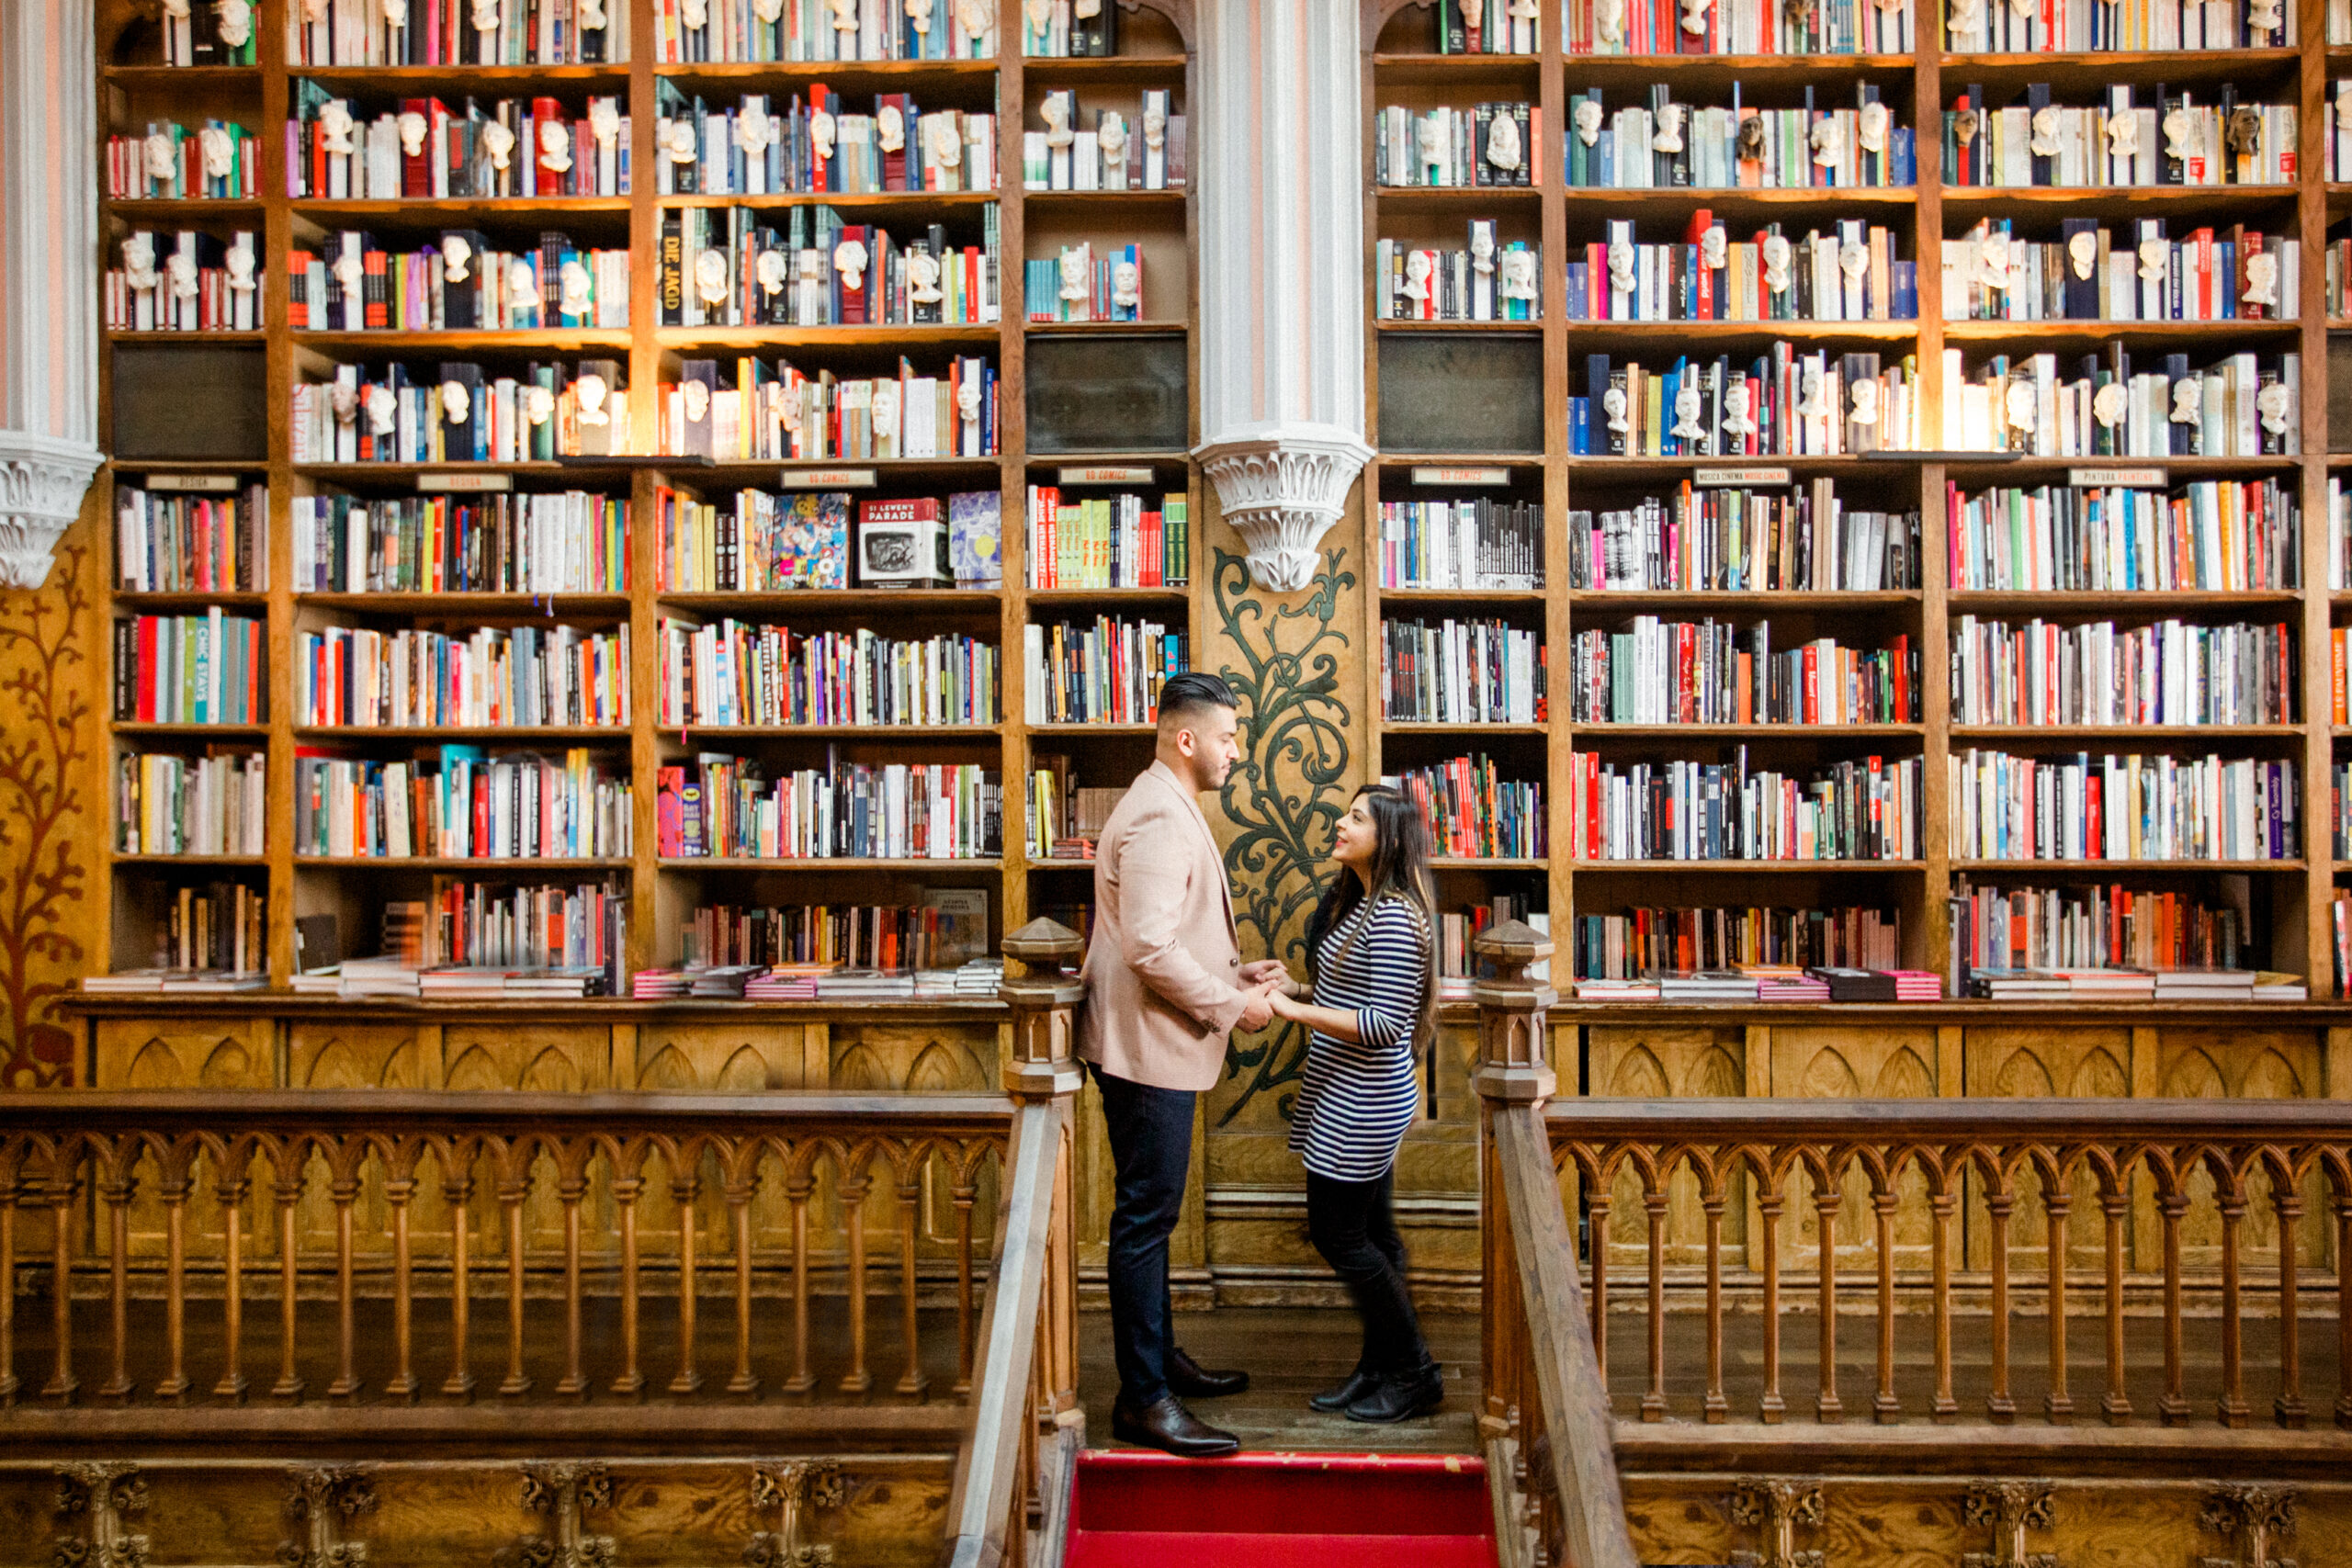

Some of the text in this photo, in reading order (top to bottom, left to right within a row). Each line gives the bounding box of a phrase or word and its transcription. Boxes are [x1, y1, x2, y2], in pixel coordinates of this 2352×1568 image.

[663, 236, 680, 310] DIE JAGD
[822, 473, 850, 483] COMICS
[1099, 469, 1127, 480] COMICS
[1453, 469, 1483, 480] COMICS
[1699, 471, 1785, 481] MUSICA CINEMA MUSIC CINEMA
[2084, 471, 2154, 481] PINTURA PAINTING
[879, 503, 914, 512] LEWEN'S
[868, 512, 914, 521] PARADE
[1037, 500, 1046, 573] JAIME HERNANDEZ
[1047, 499, 1057, 572] JAIME HERNANDEZ
[196, 626, 209, 702] CHIC STAYS
[2335, 642, 2345, 697] FAUVISME
[2271, 775, 2280, 807] Twombly
